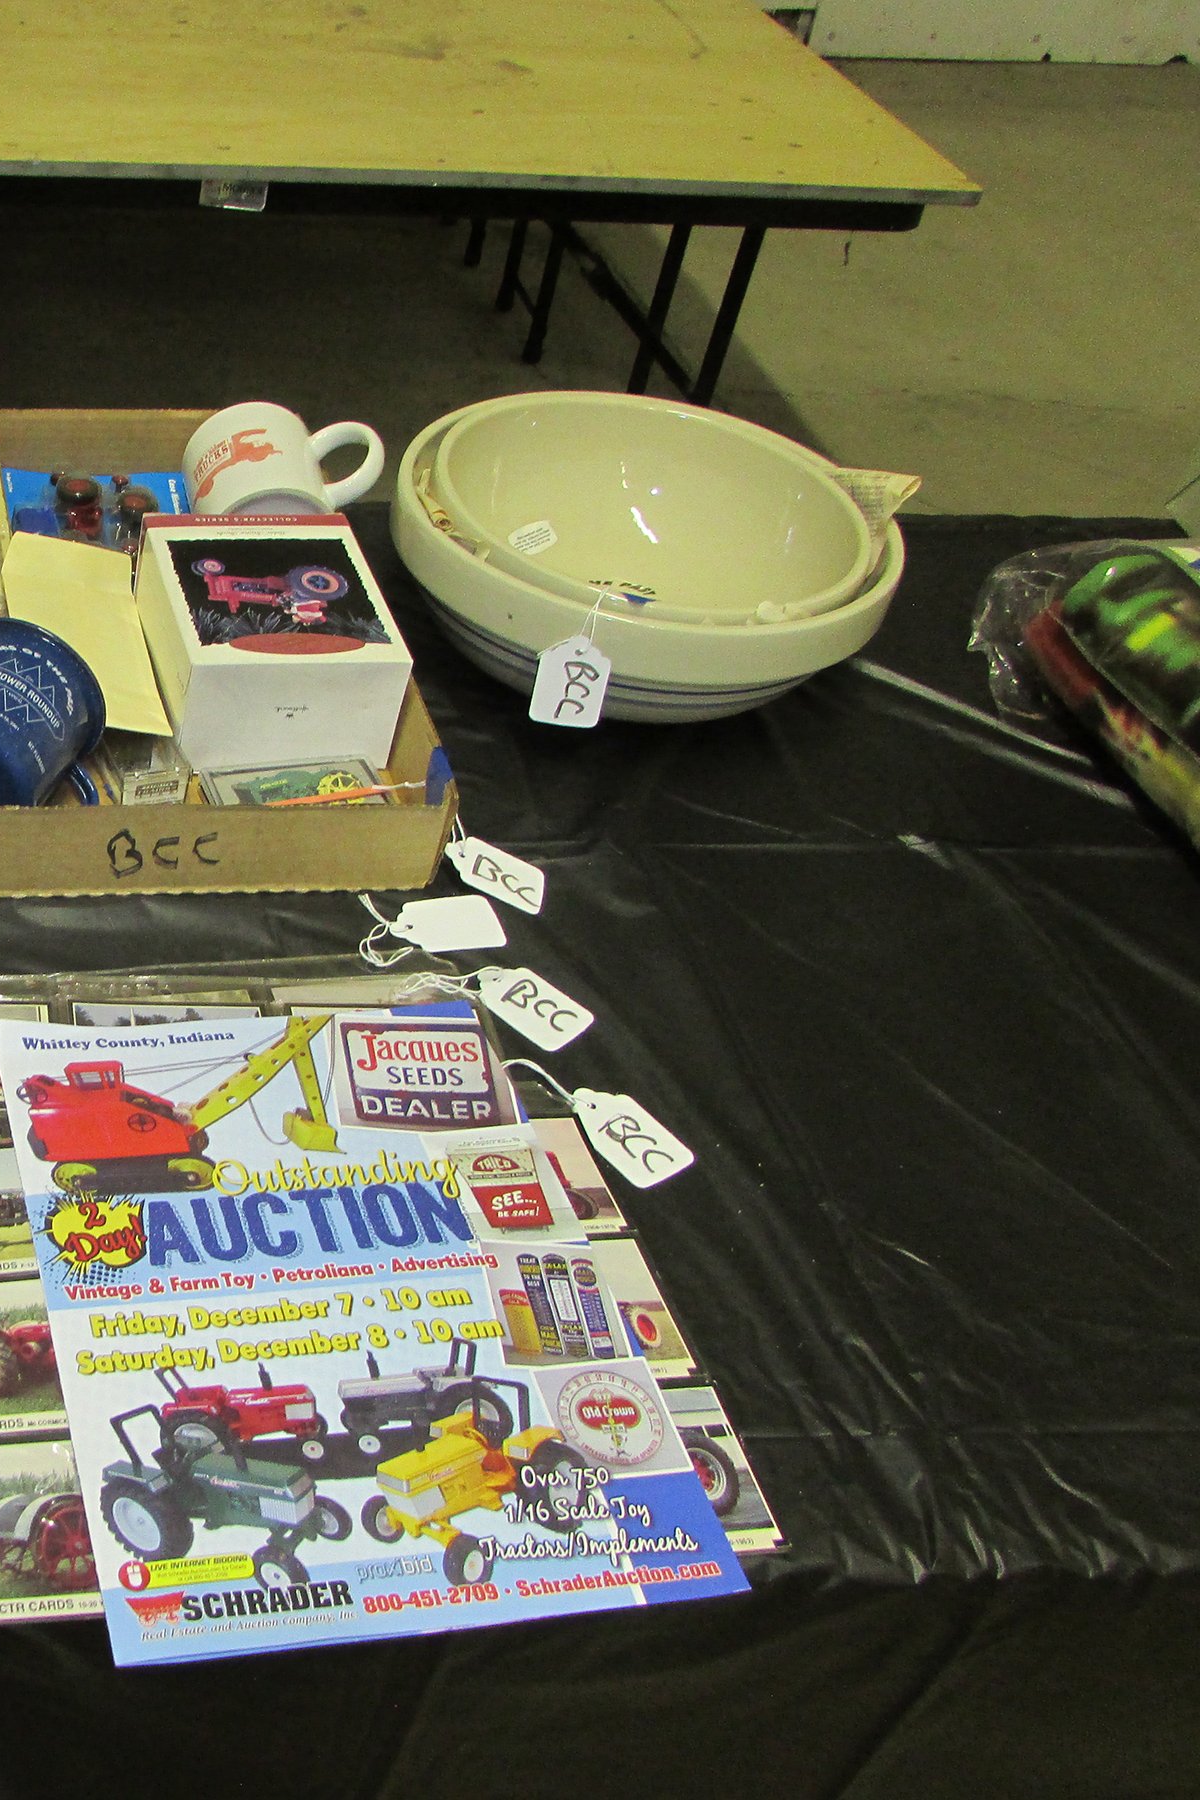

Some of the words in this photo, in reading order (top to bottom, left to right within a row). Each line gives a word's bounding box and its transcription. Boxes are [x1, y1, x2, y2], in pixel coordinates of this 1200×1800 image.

[27, 690, 61, 729] ROUNDUP
[554, 661, 600, 720] BCC
[472, 853, 541, 908] BCC
[500, 979, 578, 1032] BCC
[21, 1034, 93, 1052] Whitley
[95, 1034, 167, 1052] County,
[168, 1029, 236, 1046] Indiana
[356, 1034, 479, 1071] Jacques
[388, 1066, 464, 1087] SEEDS
[361, 1094, 493, 1121] DEALER
[597, 1112, 674, 1174] BCC
[211, 1149, 460, 1199] Outstanding
[477, 1156, 512, 1171] TRICO
[83, 1201, 108, 1231] 2
[147, 1180, 475, 1268] AUCTION
[497, 1210, 510, 1218] BE
[511, 1207, 540, 1218] SAFE!
[65, 1212, 150, 1263] Day!
[64, 1281, 143, 1301] Vintage
[149, 1279, 164, 1295] &
[170, 1275, 221, 1293] Farm
[222, 1271, 255, 1291] Toy
[273, 1261, 374, 1284] Petroliana
[391, 1252, 499, 1275] Advertising
[90, 1311, 186, 1339] Friday,
[187, 1292, 329, 1330] December
[335, 1291, 354, 1316] 7
[380, 1286, 420, 1312] 10
[427, 1287, 474, 1309] am
[75, 1342, 216, 1375] Saturday,
[217, 1326, 361, 1365] December
[367, 1323, 388, 1348] 8
[416, 1319, 454, 1345] 10
[459, 1316, 506, 1340] am
[581, 1406, 602, 1418] Old
[602, 1404, 636, 1417] Crown
[519, 1464, 568, 1489] Over
[570, 1466, 610, 1492] 750
[504, 1497, 549, 1523] 1/16
[554, 1493, 610, 1522] Scale
[610, 1492, 651, 1526] Toy
[150, 1563, 168, 1571] LIVE
[170, 1558, 211, 1570] INTERNET
[213, 1554, 249, 1565] BIDDING
[478, 1529, 699, 1568] Tractors/Implements
[21, 1599, 75, 1613] CARDS
[181, 1579, 354, 1622] SCHRADER
[362, 1582, 500, 1615] 800-451-2709
[515, 1559, 723, 1599] SchraderAuction.com
[141, 1629, 167, 1642] Real
[170, 1625, 207, 1639] Estate
[210, 1621, 232, 1633] and
[237, 1617, 279, 1630] Auction
[282, 1612, 337, 1629] Company,
[338, 1609, 358, 1620] Inc.
